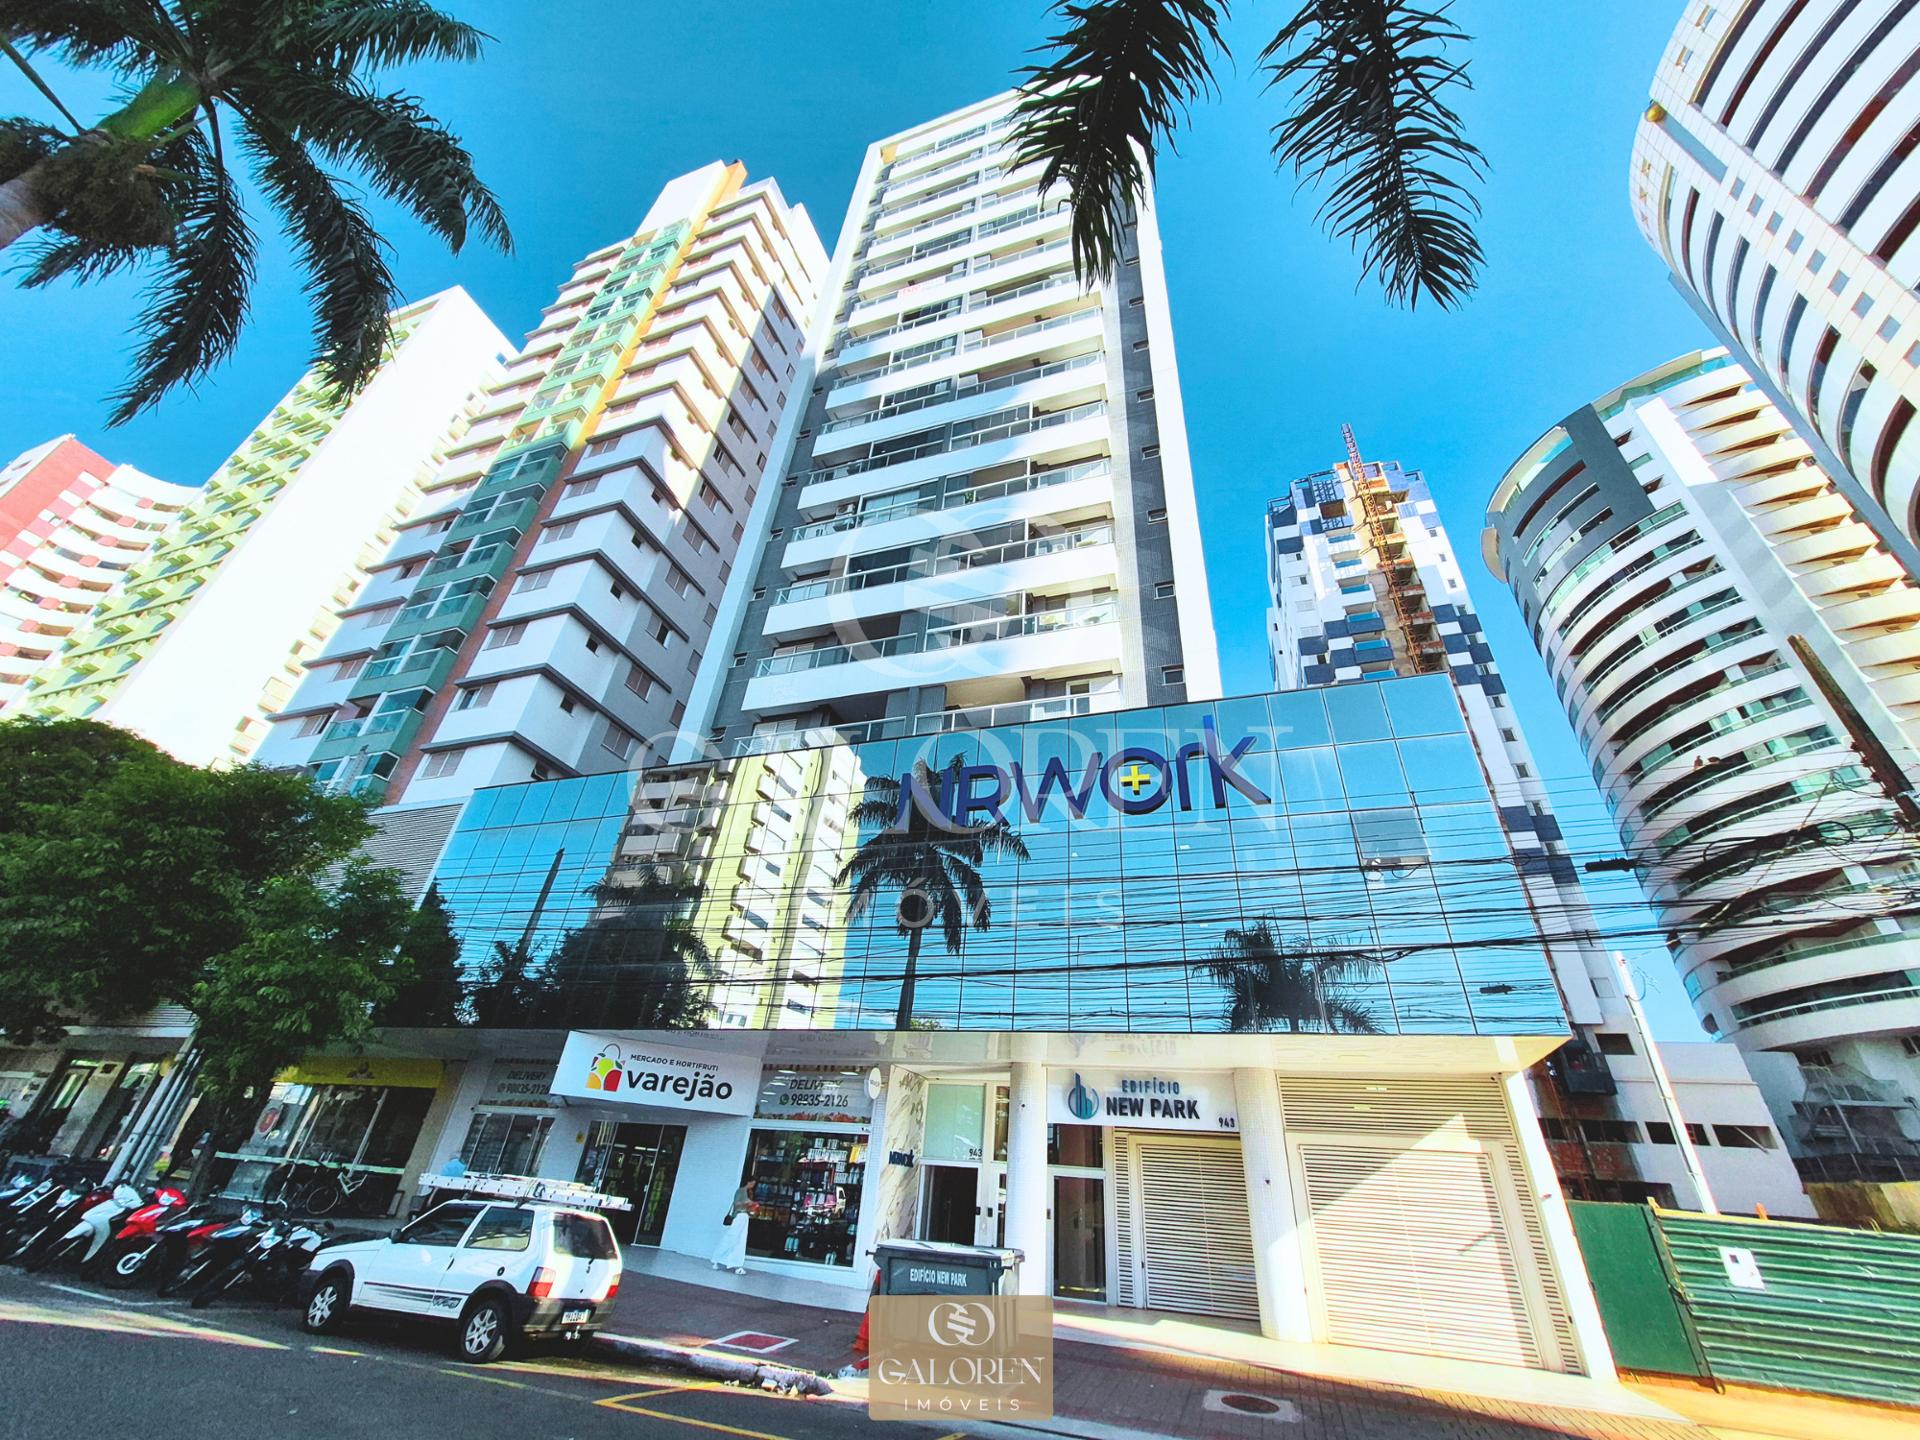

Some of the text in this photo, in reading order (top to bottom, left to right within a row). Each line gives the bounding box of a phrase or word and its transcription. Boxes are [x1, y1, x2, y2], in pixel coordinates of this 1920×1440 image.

[630, 1054, 668, 1065] MERCADO
[676, 1060, 719, 1072] HORTIFRUTI
[627, 1070, 733, 1102] varejão
[1121, 1077, 1180, 1095] EDIFÍCIO
[1106, 1097, 1200, 1119] NEW PARK
[1218, 1117, 1235, 1128] 943
[968, 1148, 983, 1157] 943
[910, 1266, 967, 1287] EDIFÍCIO NEW PARK
